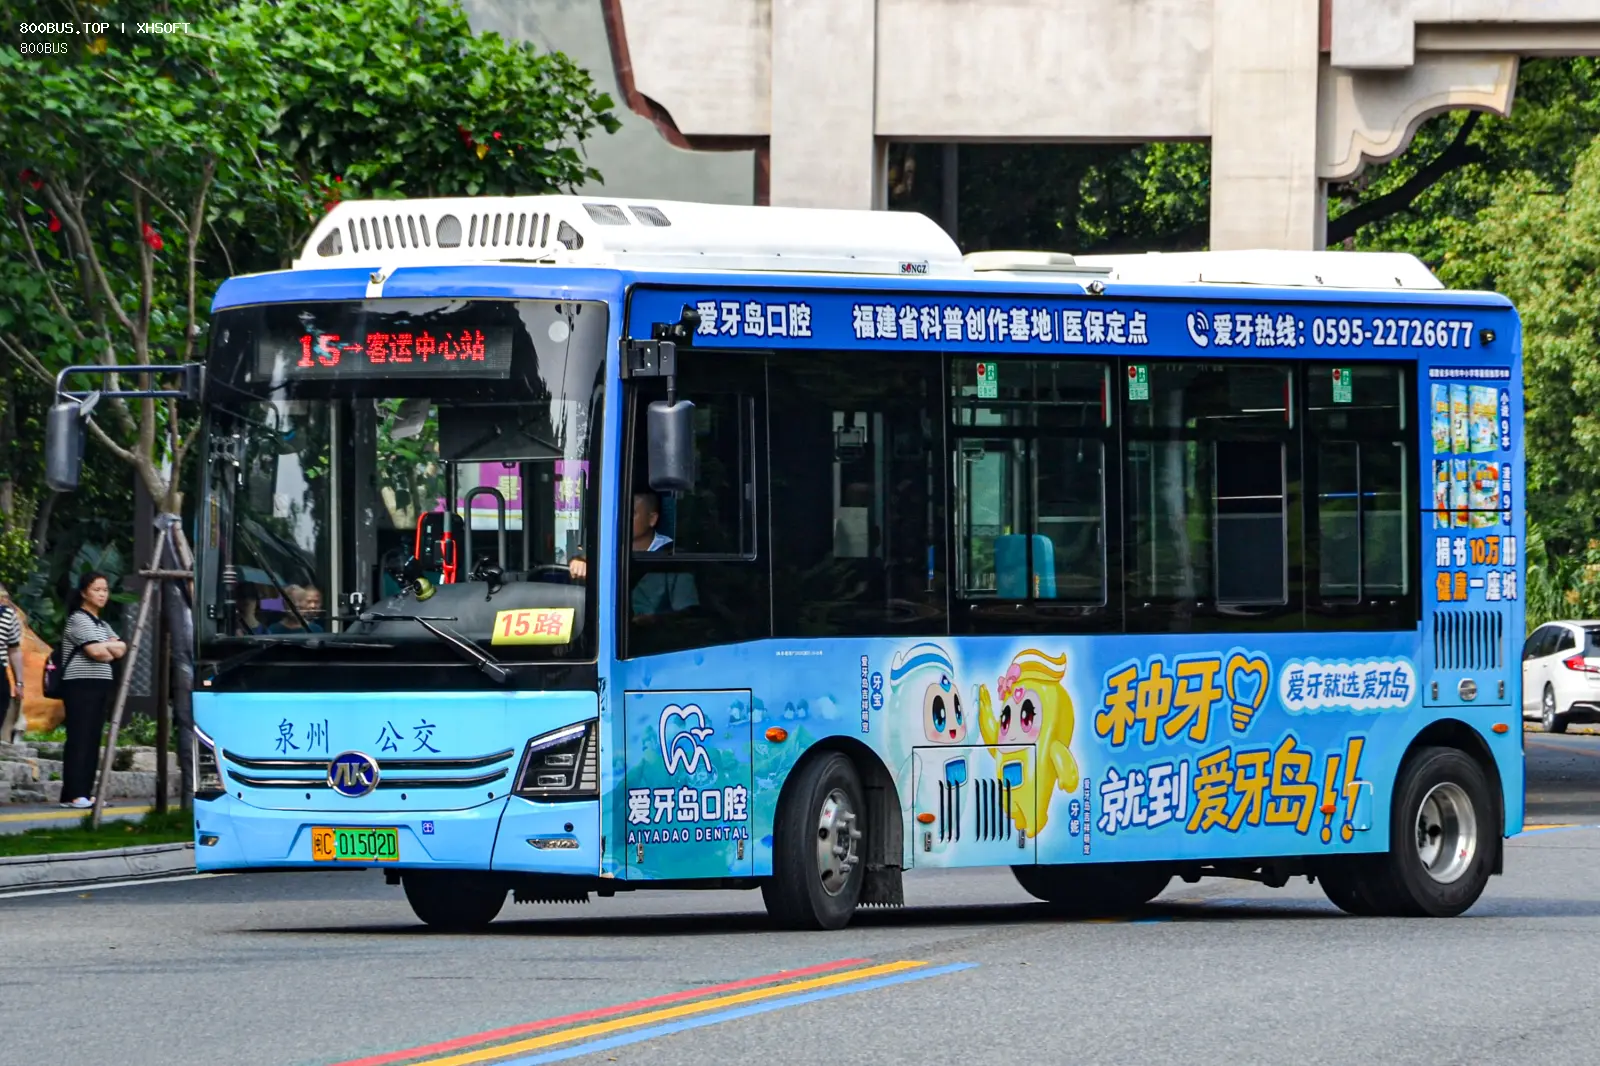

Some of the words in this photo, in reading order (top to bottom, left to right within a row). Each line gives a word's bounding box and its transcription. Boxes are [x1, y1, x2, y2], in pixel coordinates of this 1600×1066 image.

[901, 262, 927, 274] SONGZ
[696, 300, 812, 338] 爱牙岛口腔
[297, 333, 341, 367] 15
[365, 329, 485, 364] 客运中心站
[872, 675, 882, 707] 牙宝
[1095, 655, 1223, 746] 种牙
[274, 717, 330, 754] 泉州
[374, 717, 442, 754] 公交
[628, 785, 748, 825] 爱牙岛口腔
[628, 827, 690, 844] AIYADAO
[695, 826, 749, 842] DENTAL
